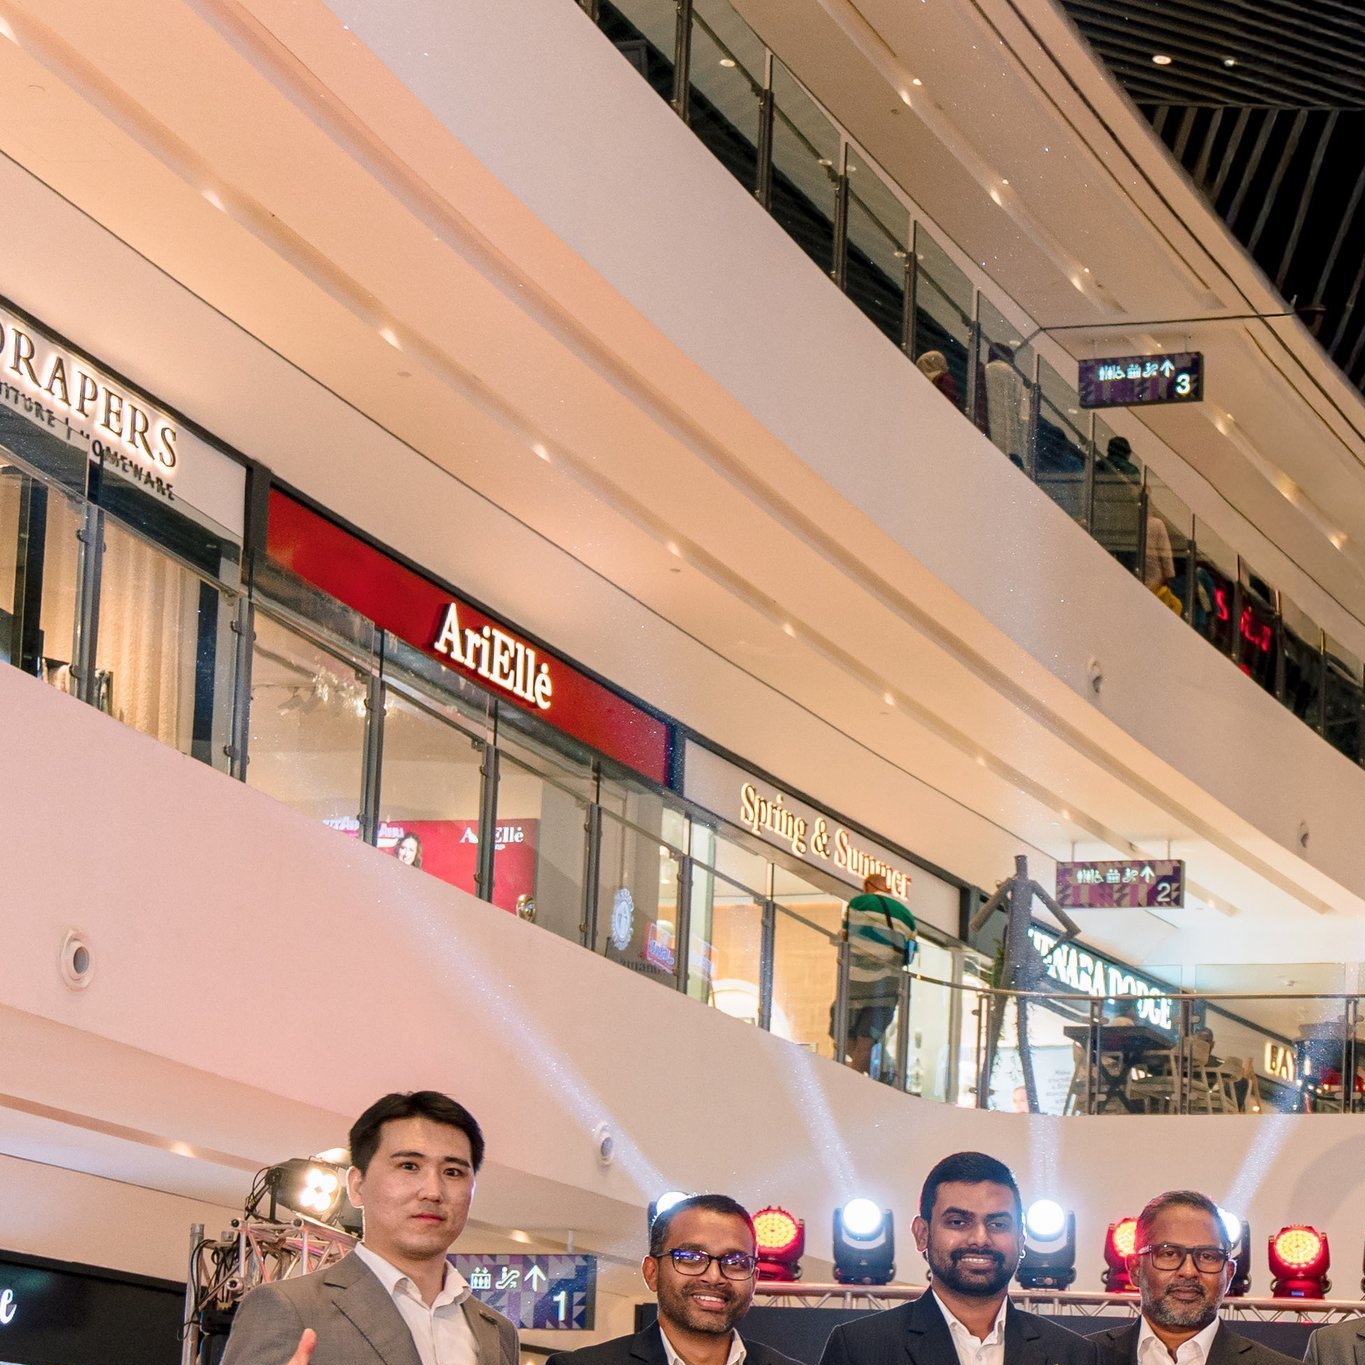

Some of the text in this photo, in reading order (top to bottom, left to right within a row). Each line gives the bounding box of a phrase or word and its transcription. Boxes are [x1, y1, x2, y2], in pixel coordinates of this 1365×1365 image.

[0, 320, 177, 468] RAPERS
[1175, 373, 1191, 395] 3
[740, 782, 807, 857] Spring
[810, 817, 831, 860] &
[1156, 882, 1171, 902] 2
[553, 1290, 567, 1321] 1
